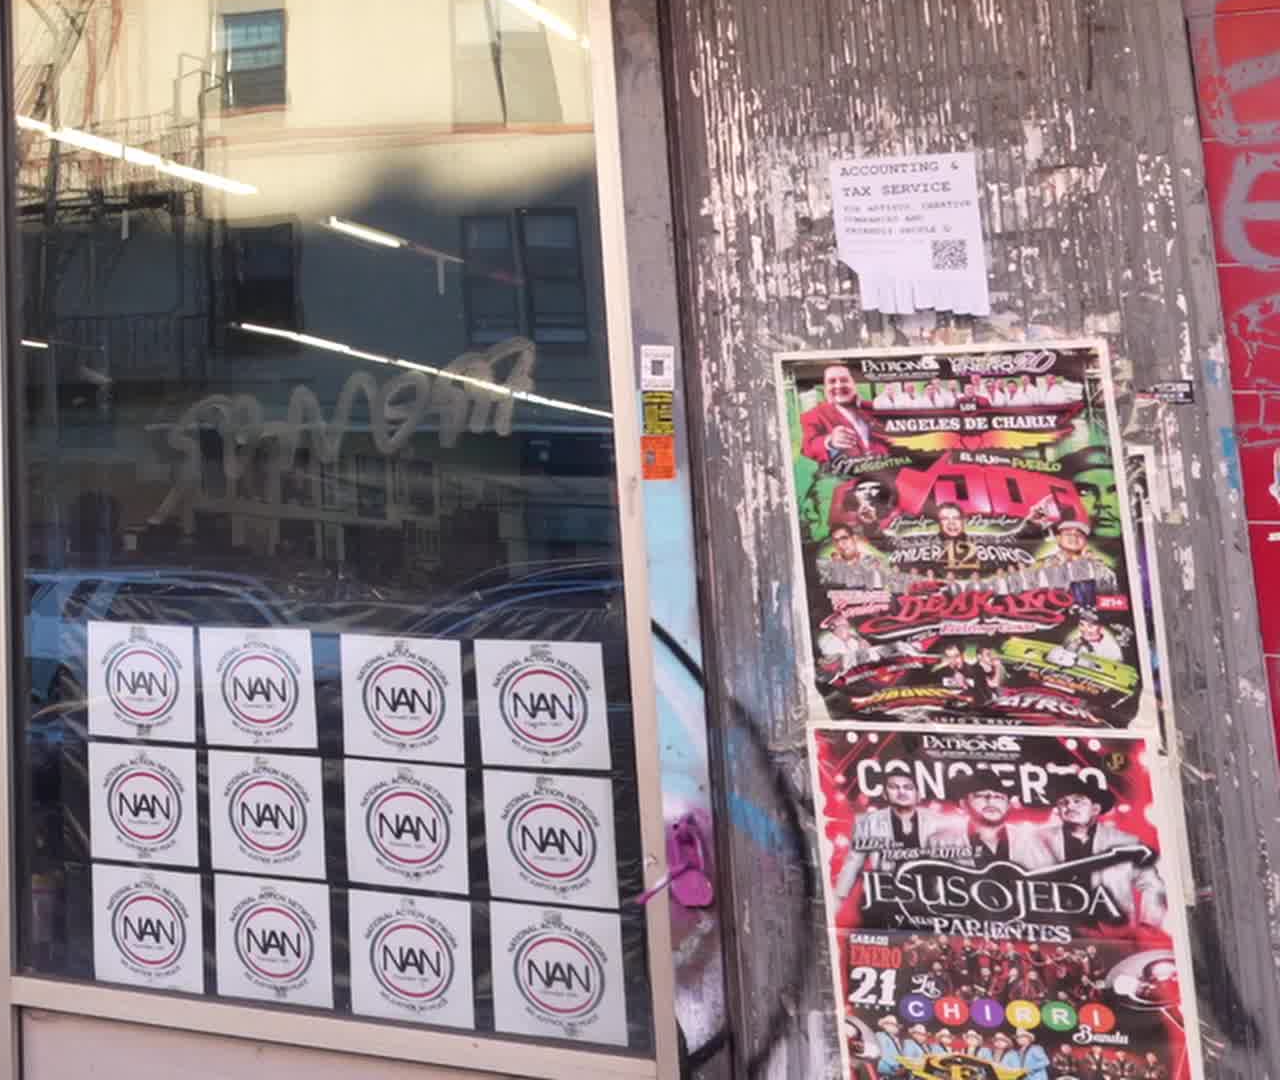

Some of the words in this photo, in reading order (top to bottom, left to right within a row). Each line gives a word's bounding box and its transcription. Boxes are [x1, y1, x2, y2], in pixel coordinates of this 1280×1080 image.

[840, 161, 939, 177] ACCOUNTING
[950, 160, 959, 170] &
[842, 186, 872, 198] TAX
[882, 181, 952, 195] SERVICE
[885, 417, 961, 432] ANGELES
[965, 416, 988, 430] DE
[991, 415, 1057, 429] CHARLY
[117, 669, 167, 697] NAN
[232, 676, 287, 703] NAN
[375, 686, 432, 715] NAN
[512, 691, 574, 721] NAN
[118, 791, 170, 819] NAN
[240, 801, 295, 831] NAN
[378, 813, 437, 843] NAN
[521, 824, 583, 857] NAN
[862, 870, 971, 910] JESUS
[970, 876, 1121, 922] OJEDA
[123, 915, 174, 945] NAN
[246, 927, 301, 959] NAN
[933, 917, 1072, 944] PARIENTES
[382, 944, 441, 977] NAN
[849, 945, 902, 968] ENERO
[527, 958, 590, 993] NAN
[848, 966, 897, 1006] 21
[905, 998, 1107, 1029] CHIRRI
